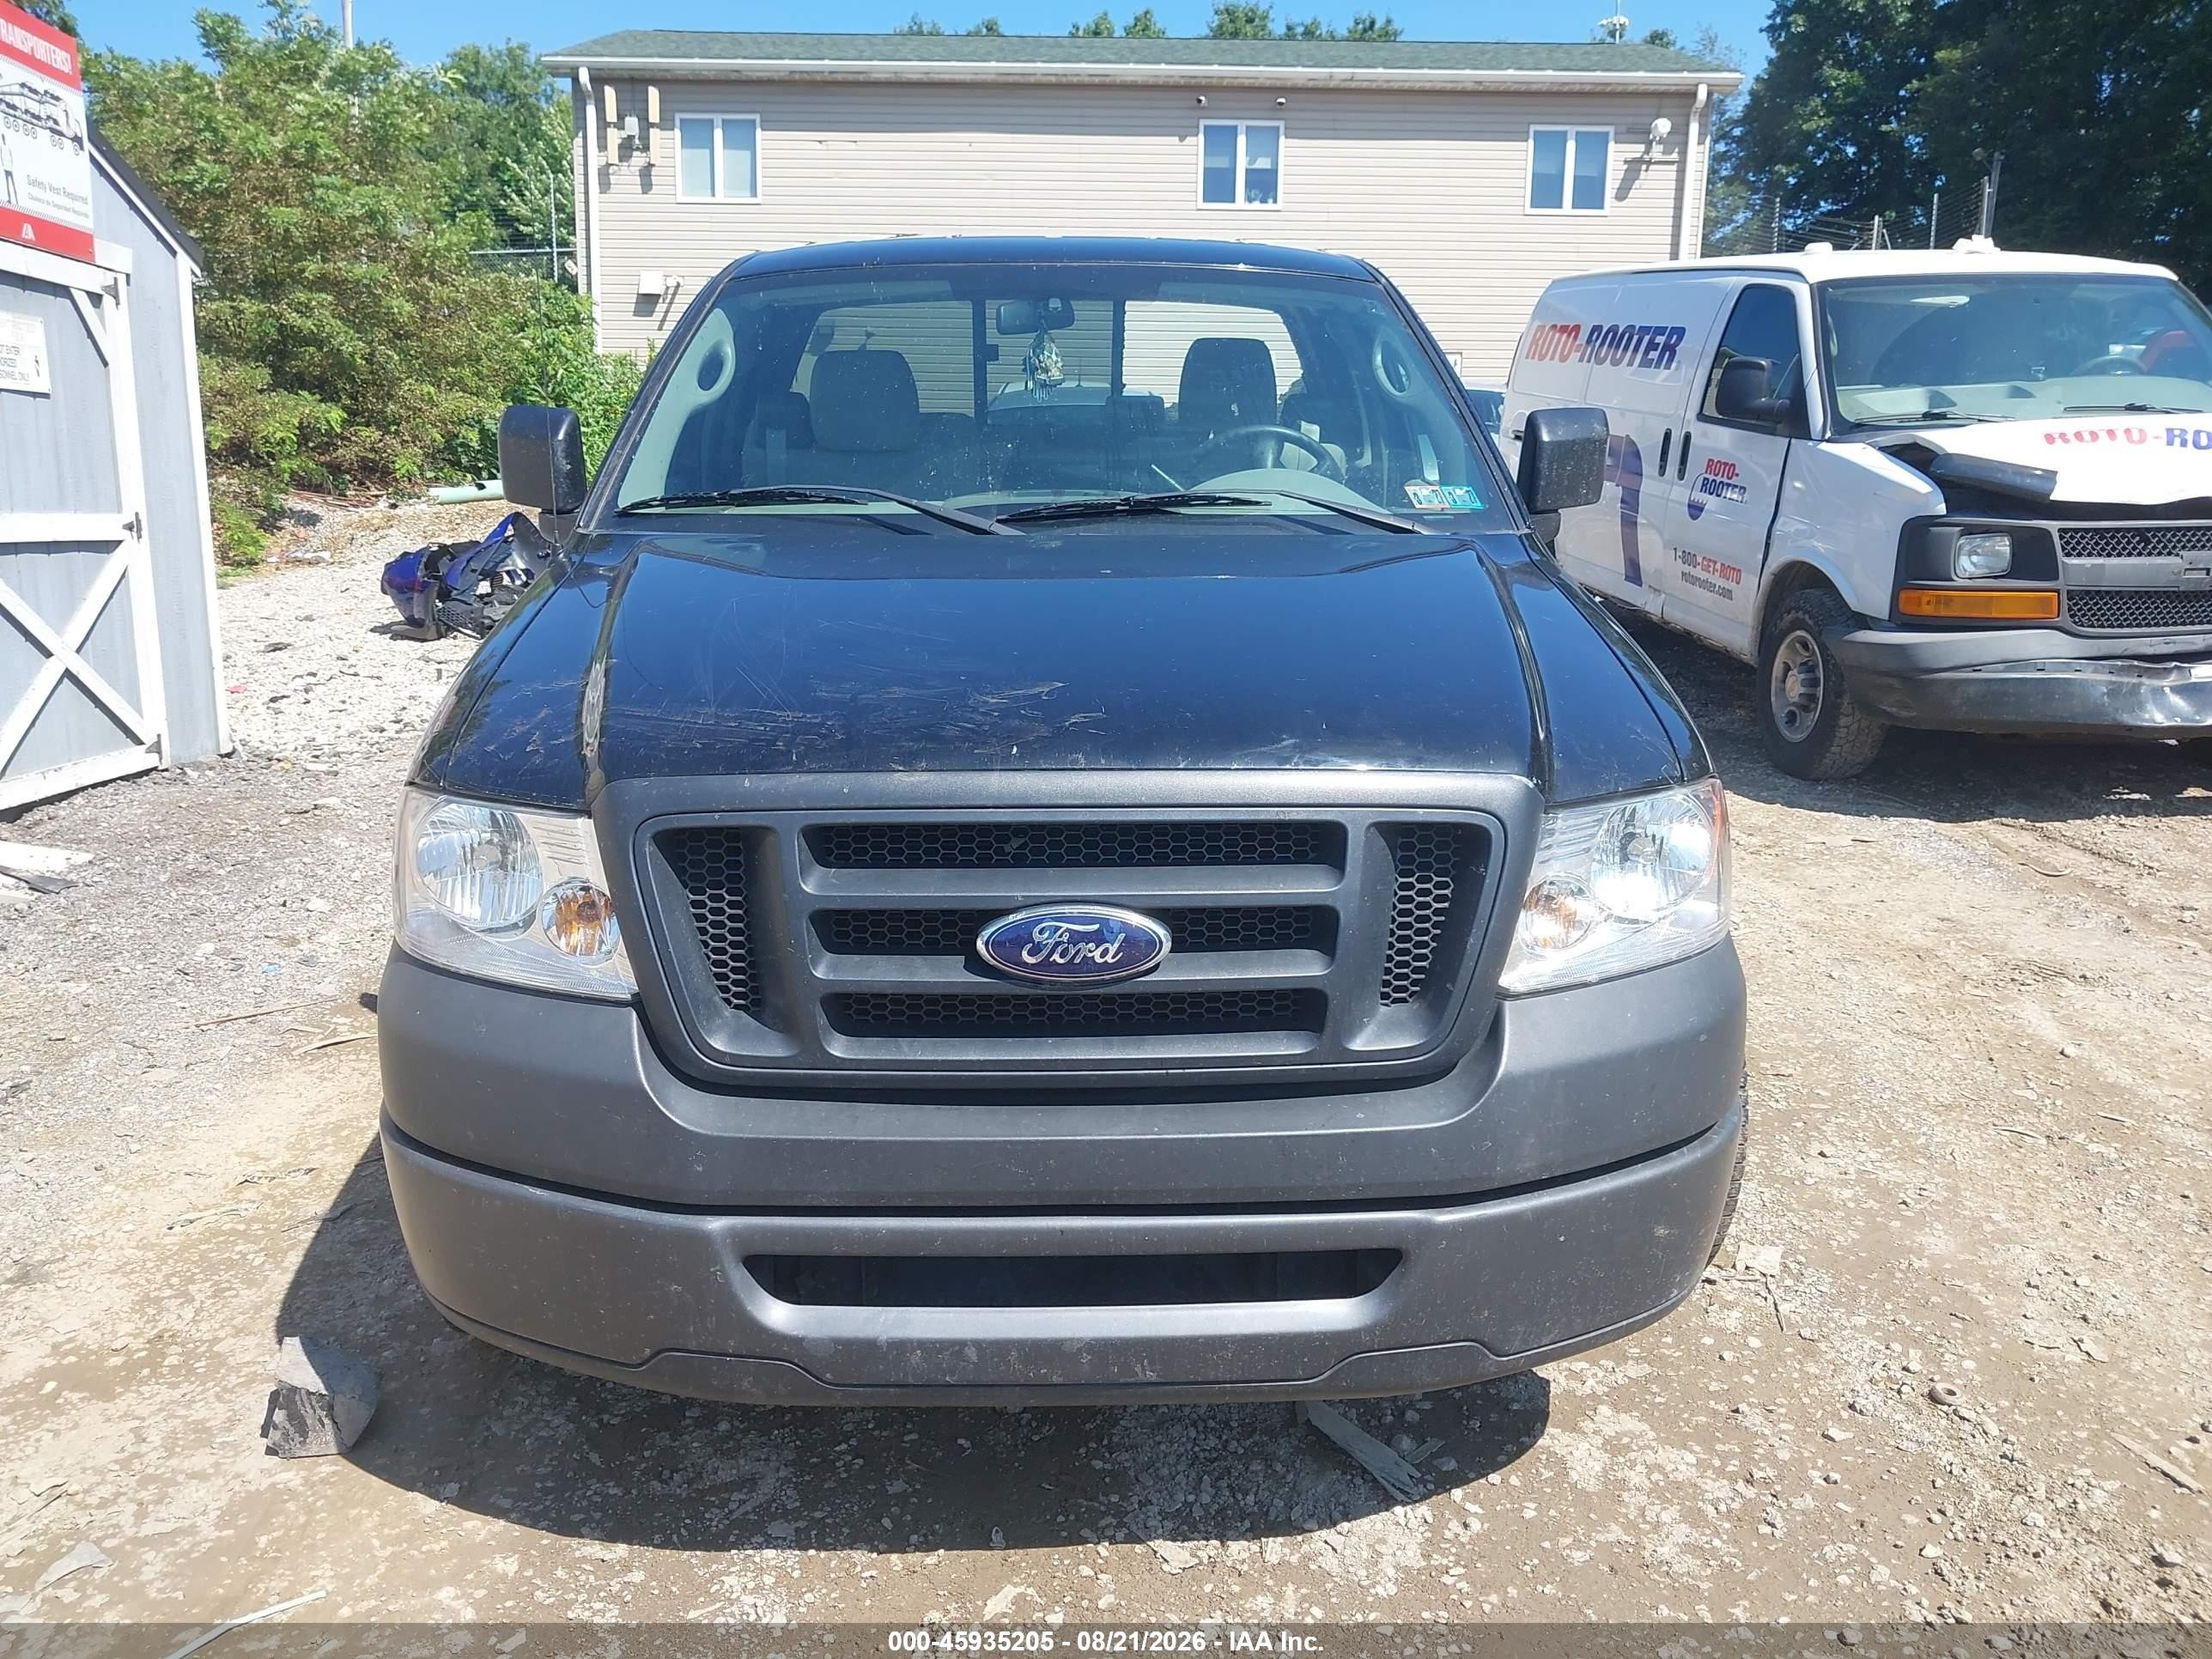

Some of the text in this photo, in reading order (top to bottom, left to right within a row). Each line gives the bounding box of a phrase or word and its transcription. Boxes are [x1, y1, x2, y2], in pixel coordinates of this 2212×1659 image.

[27, 174, 46, 192] Safety
[48, 181, 62, 196] Vest
[1525, 323, 1686, 370] ROTO-ROOTER
[1704, 458, 1740, 481] ROTO-
[1699, 477, 1747, 504] ROOTER
[1674, 547, 1742, 585] 1-800-GET-ROTO
[1680, 569, 1734, 601] rotorooter.com
[1021, 921, 1127, 963] Ford
